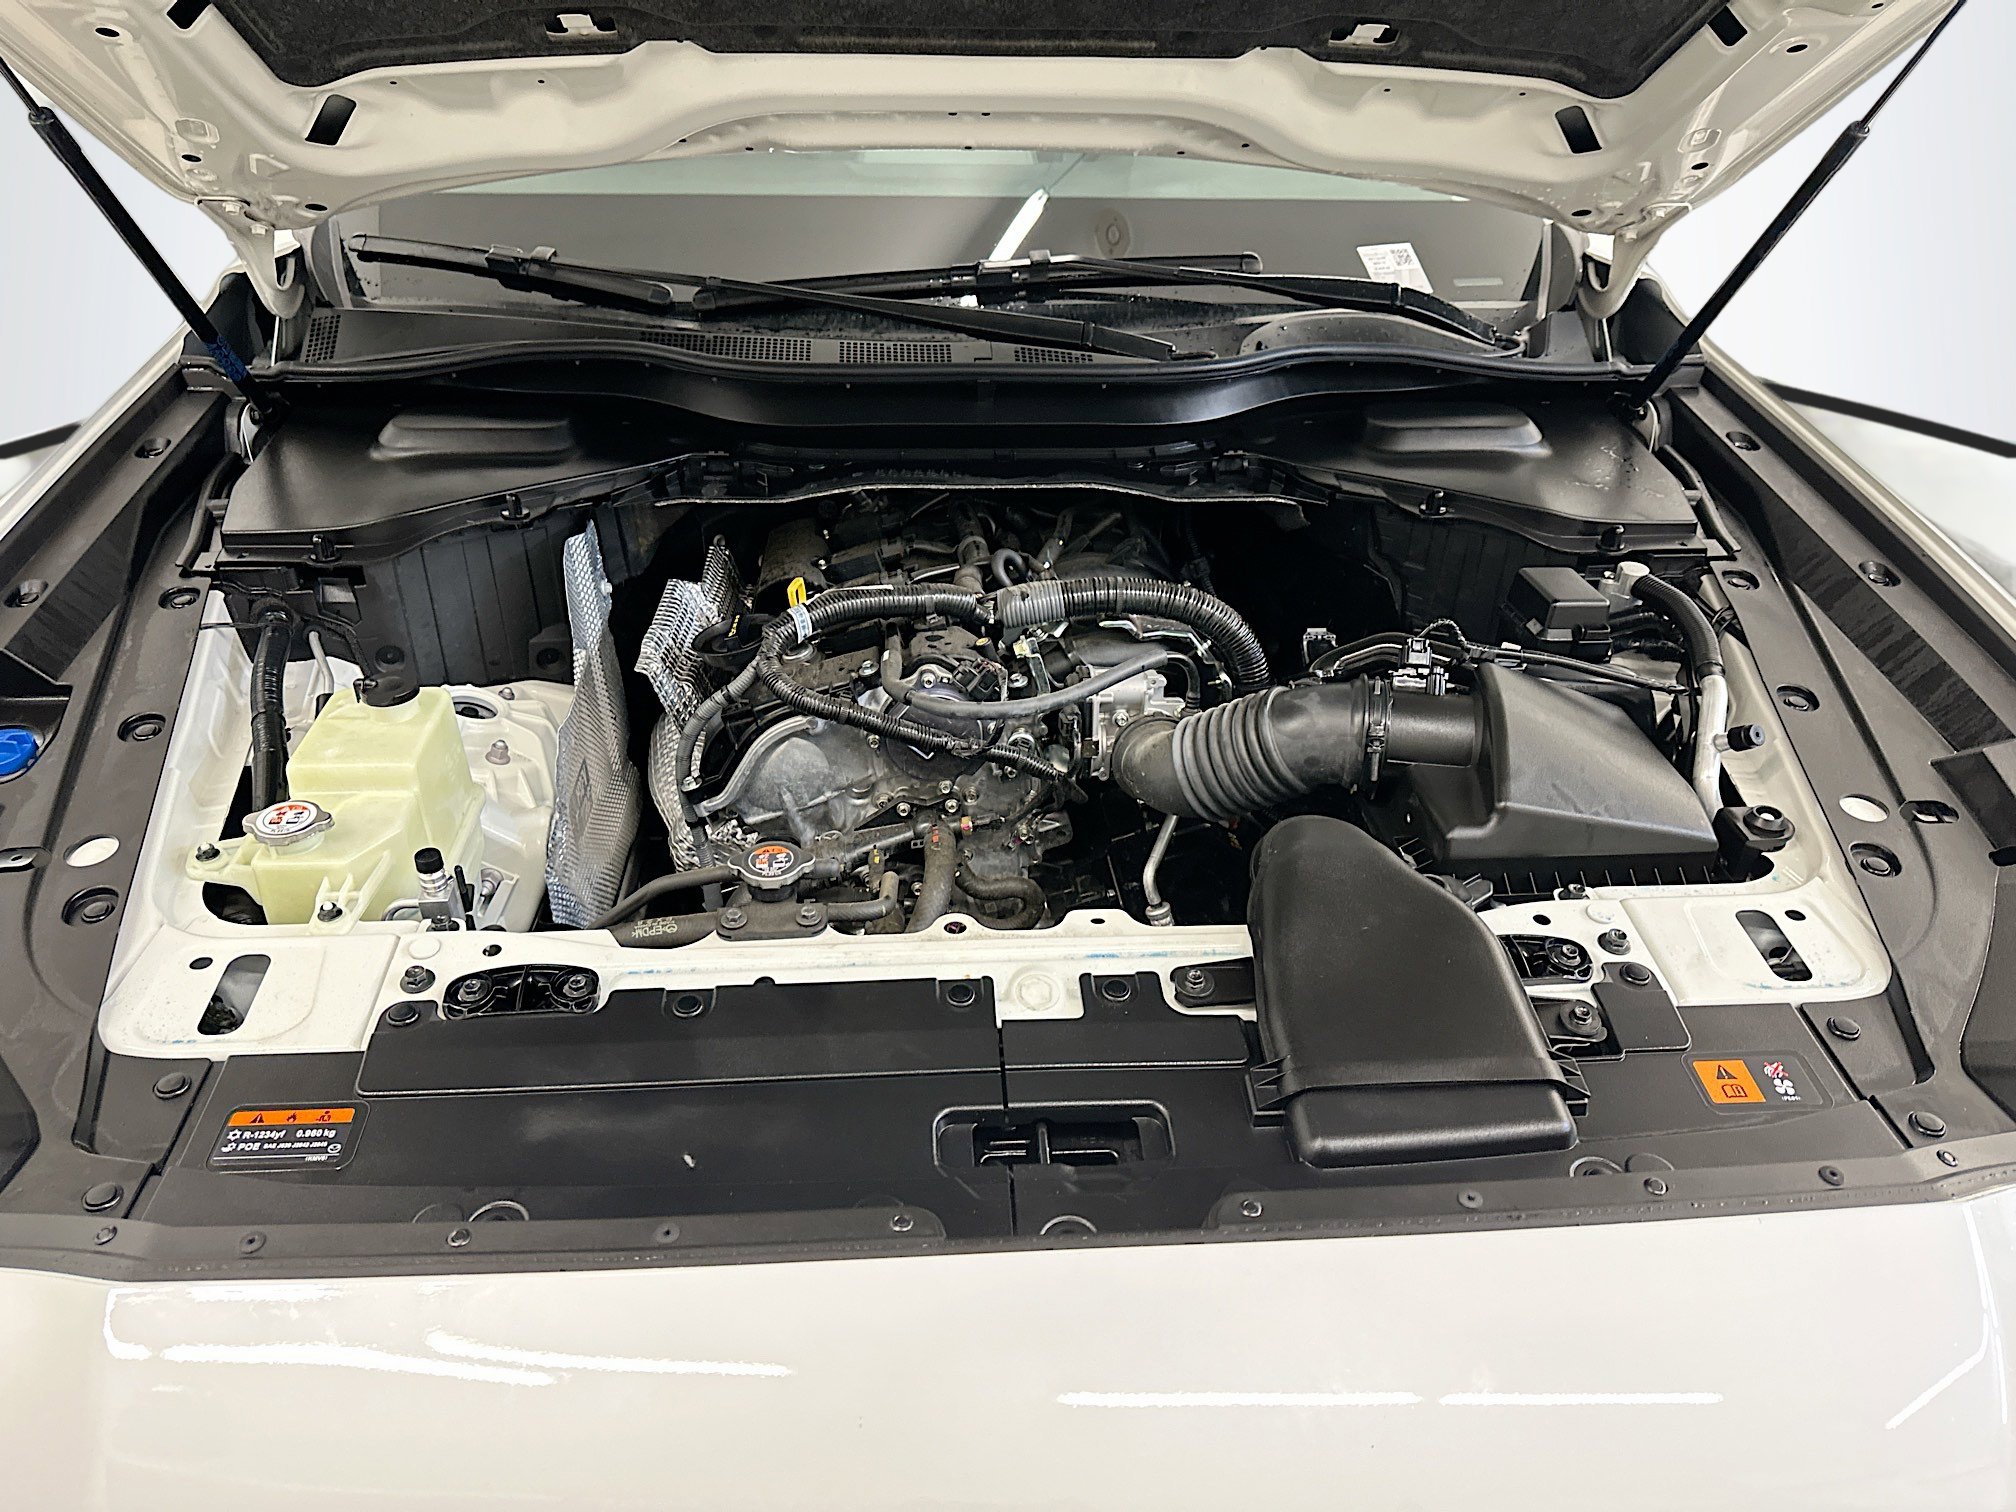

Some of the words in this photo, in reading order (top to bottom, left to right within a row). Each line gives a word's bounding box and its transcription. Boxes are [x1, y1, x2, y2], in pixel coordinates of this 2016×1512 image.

[241, 1129, 287, 1141] R-1234yf
[323, 1129, 337, 1139] kg
[237, 1142, 261, 1151] POE
